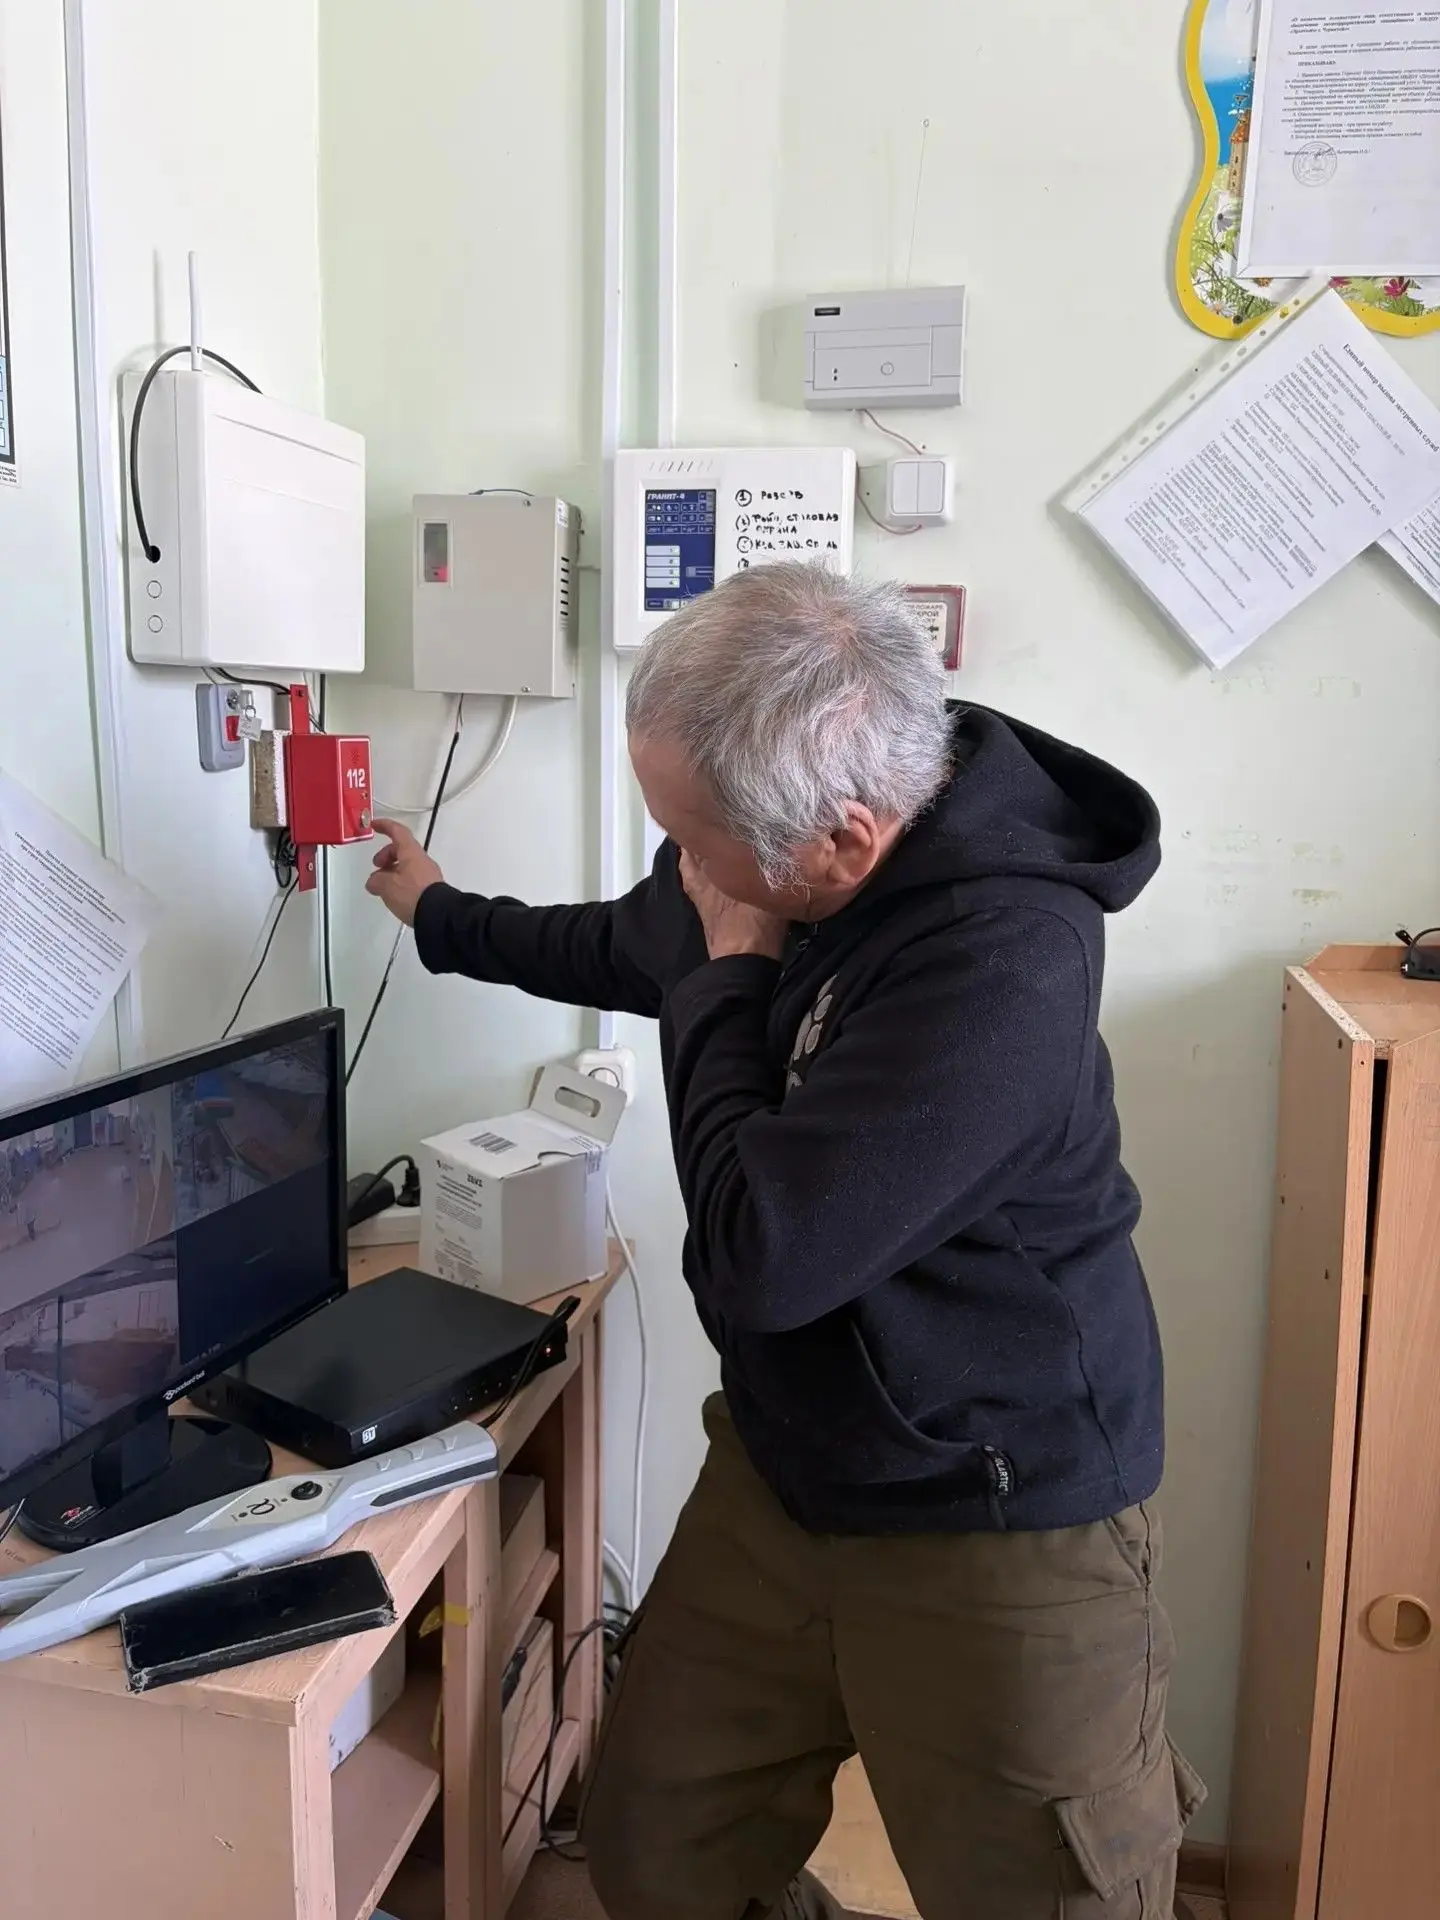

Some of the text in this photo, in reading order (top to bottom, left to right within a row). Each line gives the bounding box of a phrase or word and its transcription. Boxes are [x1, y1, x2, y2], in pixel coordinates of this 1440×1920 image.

[1343, 344, 1365, 367] Единый
[1363, 367, 1378, 384] номер
[346, 768, 366, 789] 112
